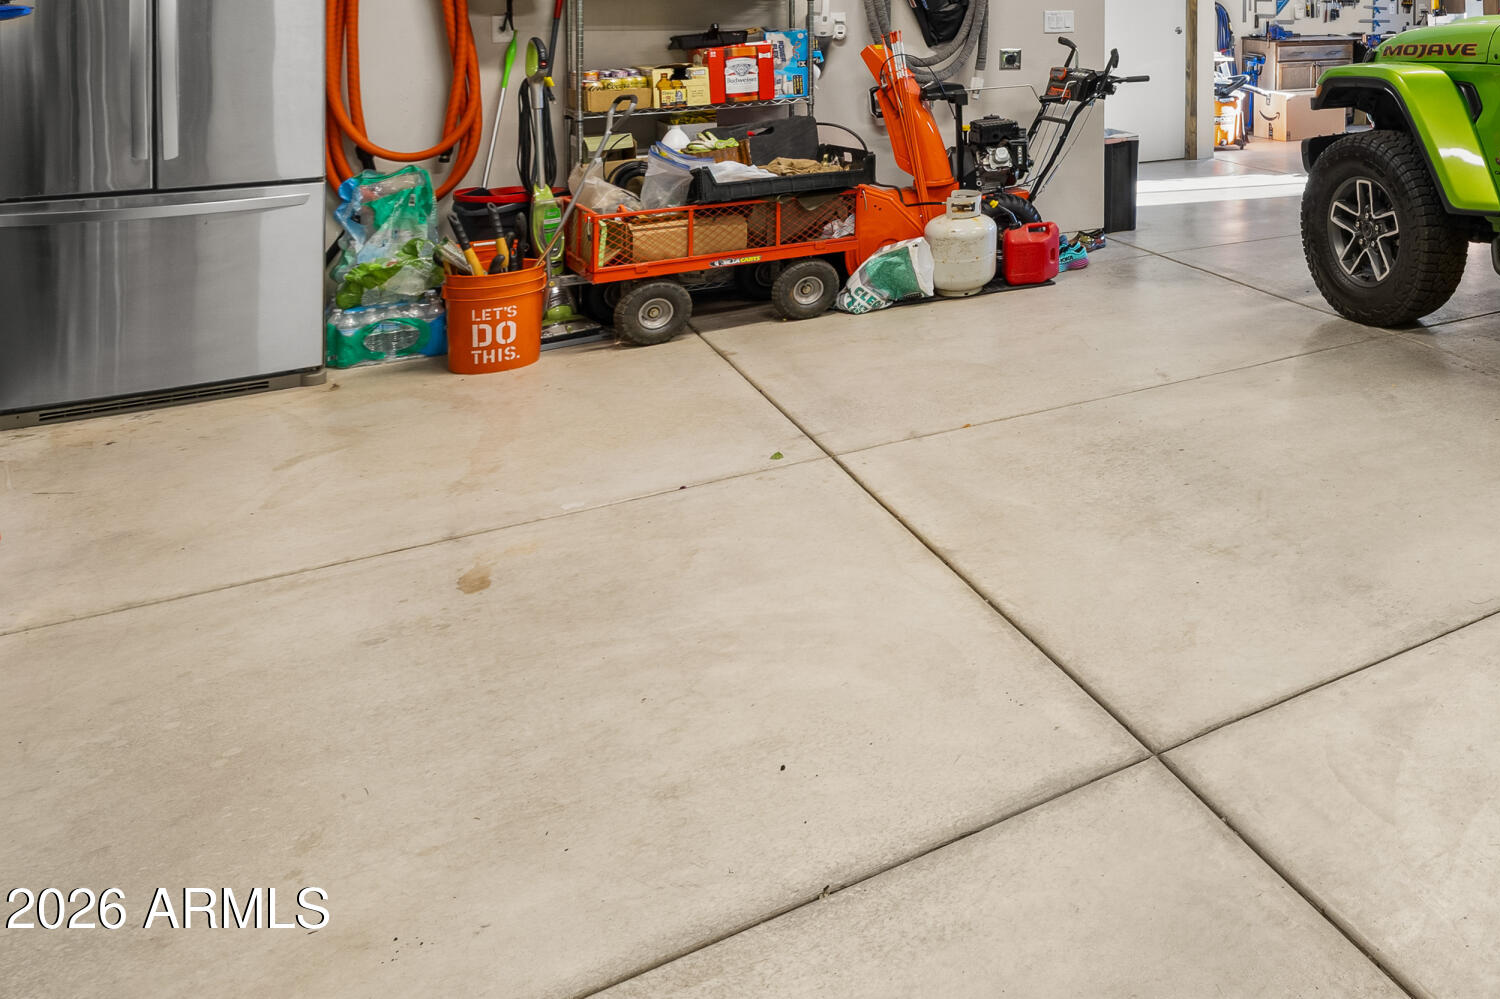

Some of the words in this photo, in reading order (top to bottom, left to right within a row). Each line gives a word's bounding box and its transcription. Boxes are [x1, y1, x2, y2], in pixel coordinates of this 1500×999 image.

[1382, 43, 1478, 58] MOJAVE
[471, 305, 517, 322] LET'S
[471, 320, 517, 348] DO
[471, 346, 520, 365] THIS.
